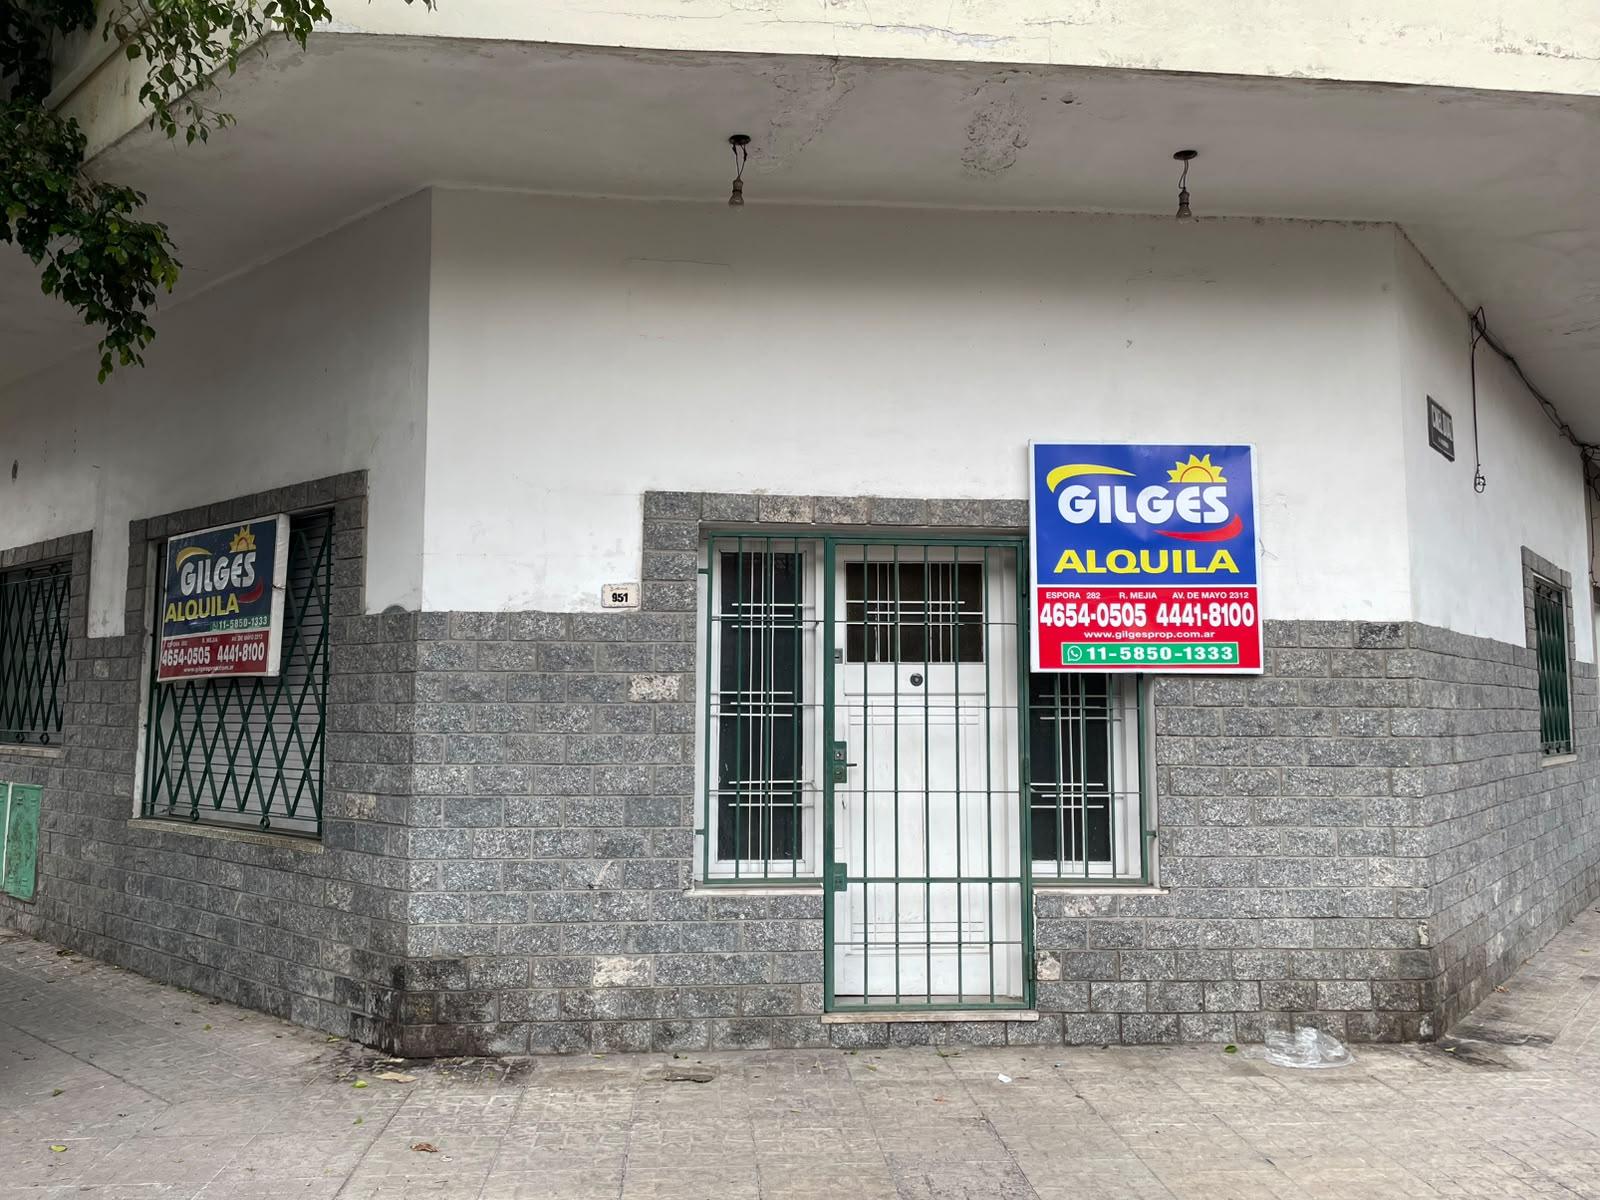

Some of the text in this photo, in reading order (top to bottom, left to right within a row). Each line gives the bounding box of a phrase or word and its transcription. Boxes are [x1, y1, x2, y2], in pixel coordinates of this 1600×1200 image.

[1057, 484, 1230, 525] GILGES
[1053, 549, 1240, 574] ALQUILA
[180, 551, 257, 596] GILGES
[611, 592, 629, 603] 951
[1045, 591, 1101, 600] ESPORA 282
[1118, 591, 1158, 599] R. MEJIA
[1172, 591, 1249, 599] AV. DE MAYO 2312
[164, 593, 240, 622] ALQUILA
[1039, 602, 1255, 628] 4654-0505 4441-8100
[219, 615, 268, 629] 11-5850-1333
[1083, 630, 1216, 640] www.gilgesprop.com.ar
[162, 641, 265, 667] 4654-0505 4441-8100
[1086, 646, 1233, 661] 11-5850-1333
